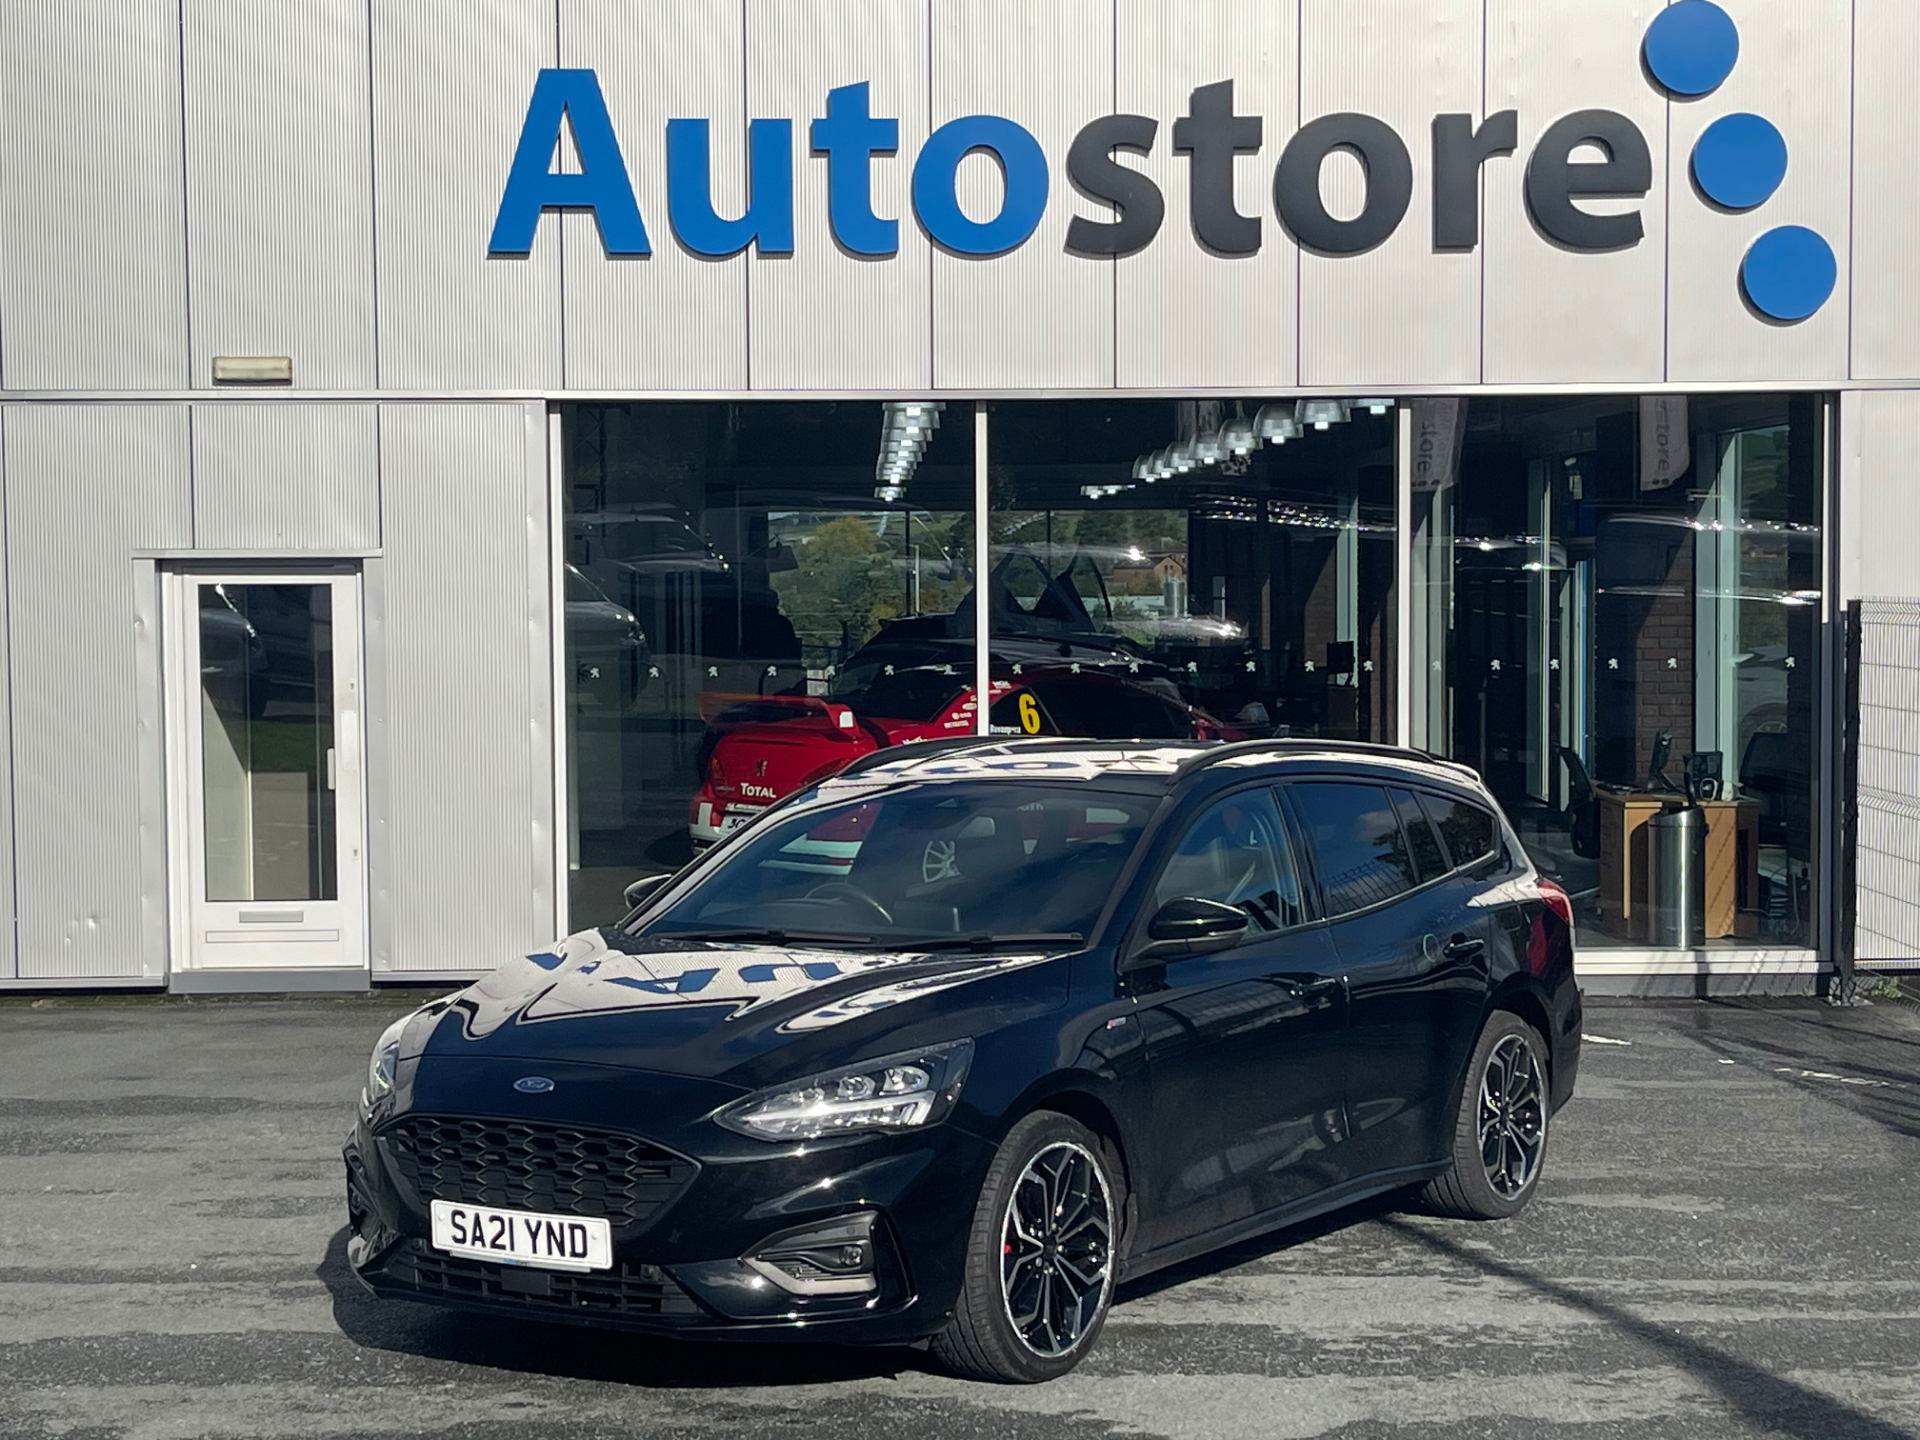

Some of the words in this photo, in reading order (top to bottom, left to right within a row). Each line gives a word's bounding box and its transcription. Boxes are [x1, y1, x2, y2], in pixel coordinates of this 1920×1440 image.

[1019, 693, 1041, 735] 6
[740, 782, 777, 799] TOTAL
[450, 1209, 517, 1252] SA21
[524, 1218, 589, 1259] YND
